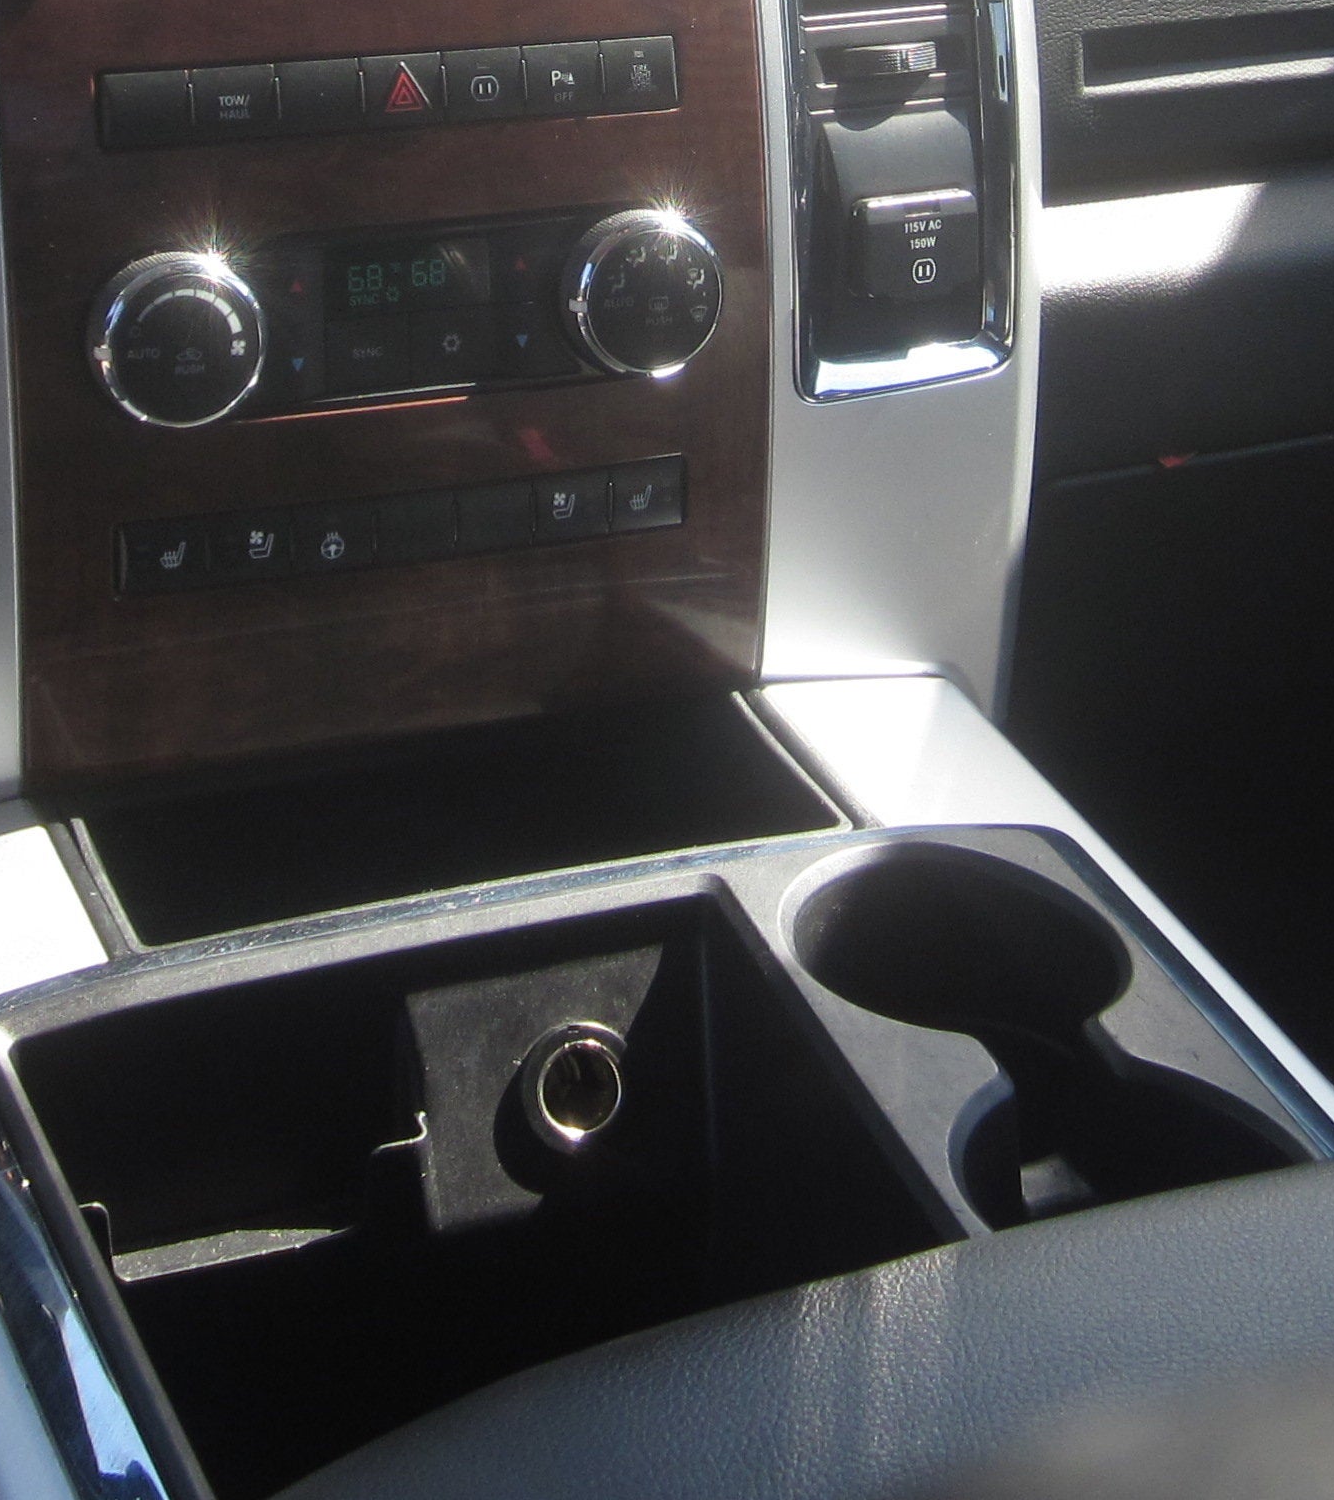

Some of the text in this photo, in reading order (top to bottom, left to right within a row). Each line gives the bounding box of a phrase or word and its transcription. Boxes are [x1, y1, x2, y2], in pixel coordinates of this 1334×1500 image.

[218, 94, 250, 107] TOW/
[219, 108, 250, 119] HAUL
[904, 219, 942, 234] 115V AC
[909, 236, 936, 250] 150W
[348, 260, 445, 292] 68 68
[348, 294, 379, 307] SYNC
[127, 348, 161, 361] AUTO
[352, 345, 383, 358] SYNC
